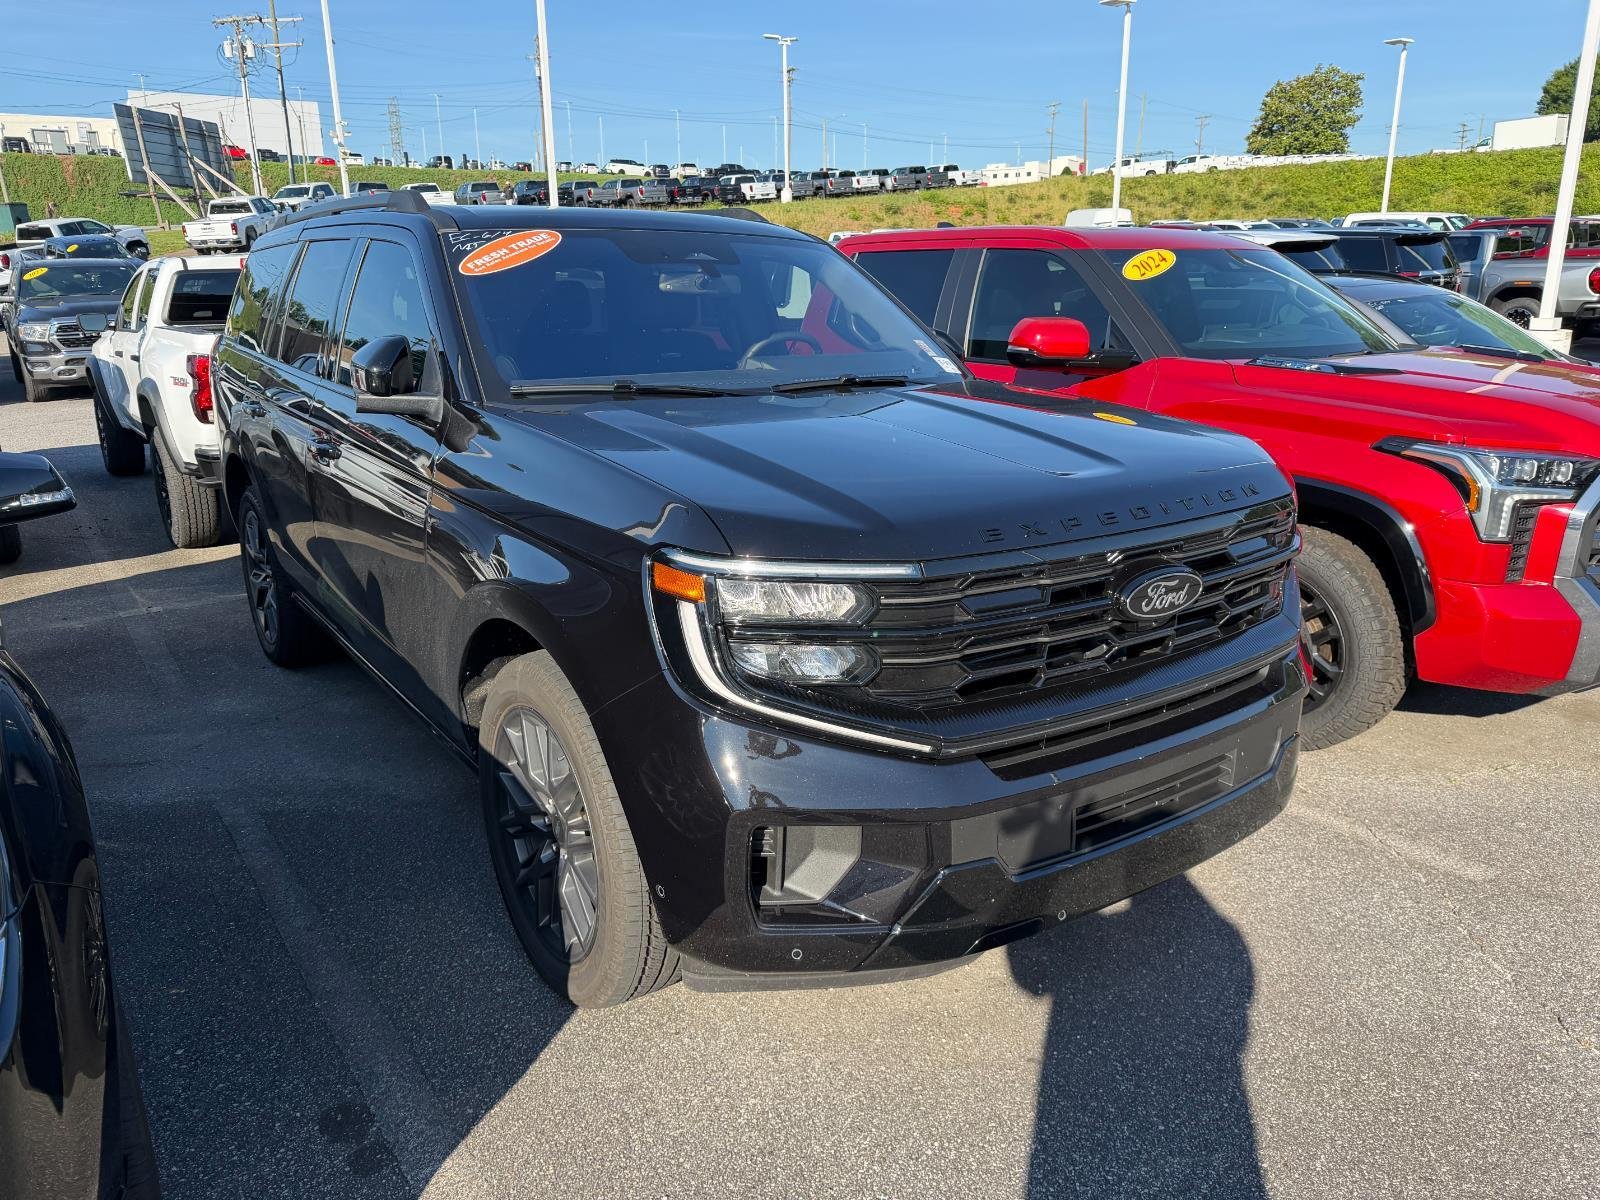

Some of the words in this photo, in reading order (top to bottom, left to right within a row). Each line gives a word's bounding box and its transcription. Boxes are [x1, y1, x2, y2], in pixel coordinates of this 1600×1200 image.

[466, 248, 508, 269] FRESH
[509, 232, 551, 250] TRADE
[1132, 252, 1167, 277] 2024
[979, 480, 1260, 543] EXPEDITION
[1142, 578, 1189, 612] Ford
